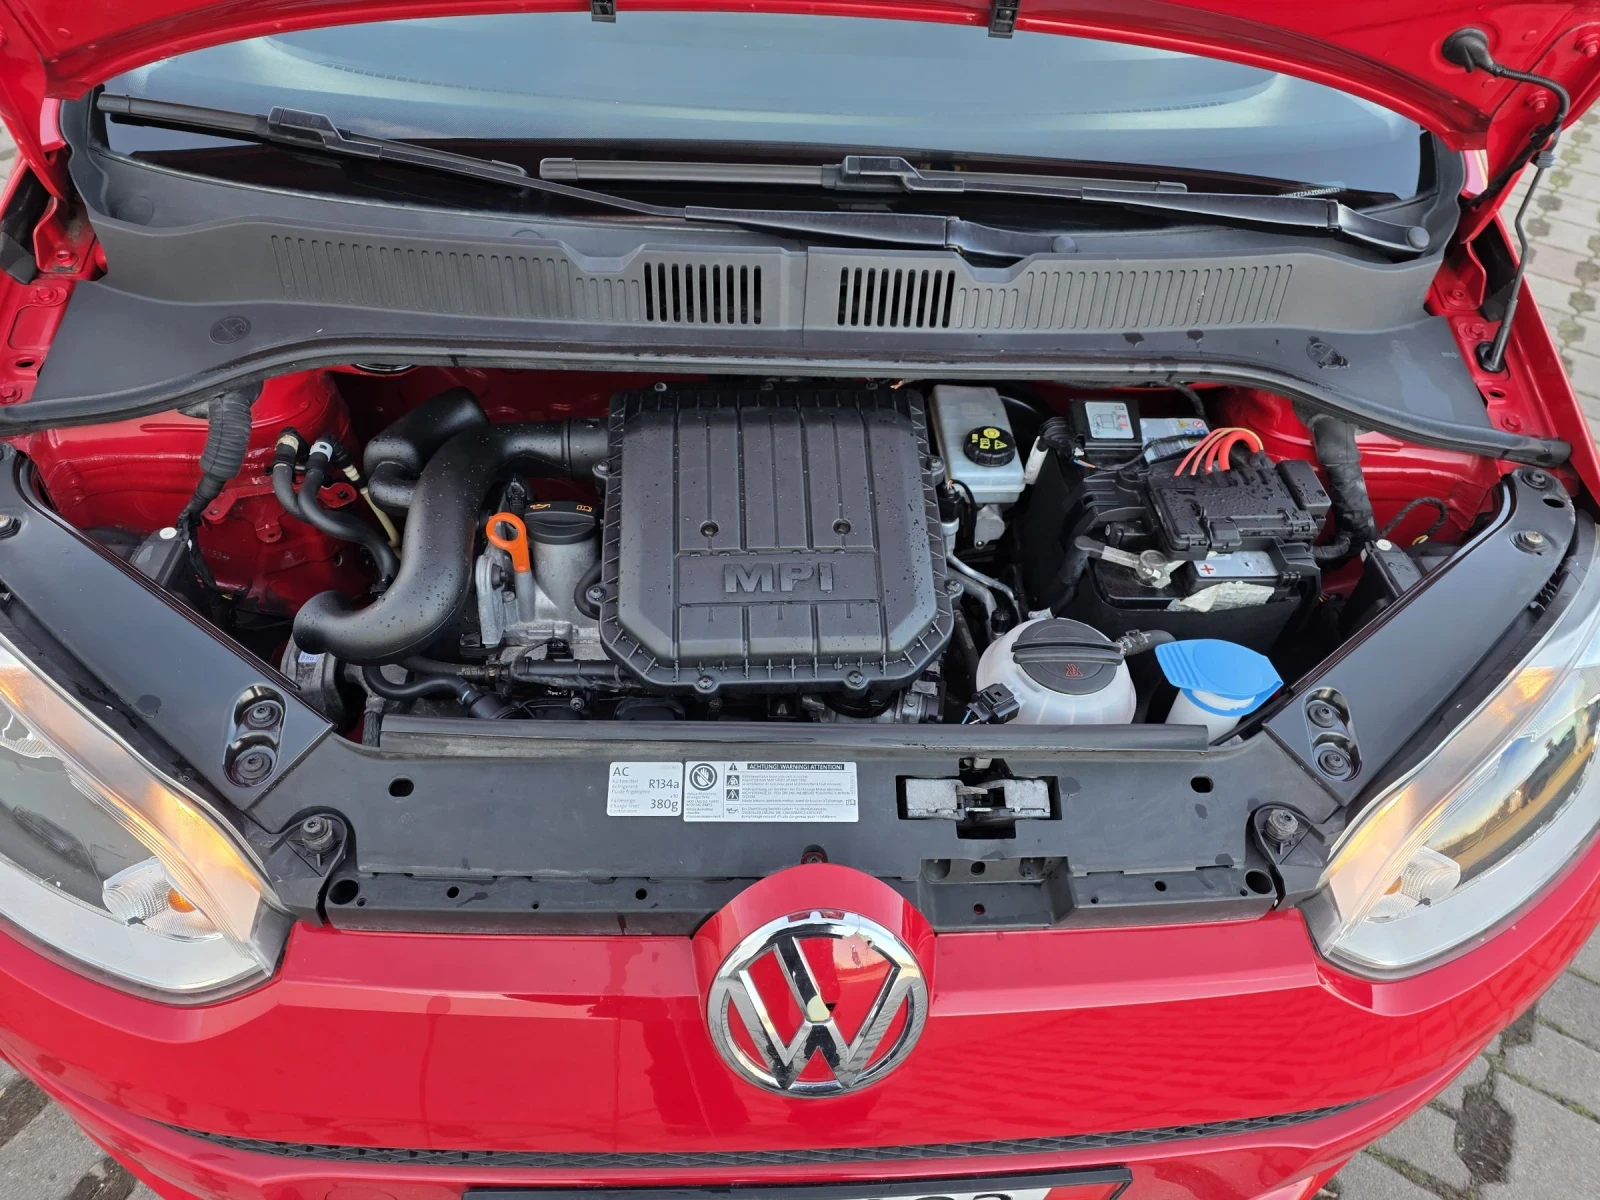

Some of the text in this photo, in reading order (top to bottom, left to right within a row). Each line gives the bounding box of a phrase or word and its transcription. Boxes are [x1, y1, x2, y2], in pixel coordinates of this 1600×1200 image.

[724, 562, 834, 593] MPI
[612, 766, 630, 777] AC
[648, 778, 680, 789] R134a
[650, 798, 679, 813] 380g
